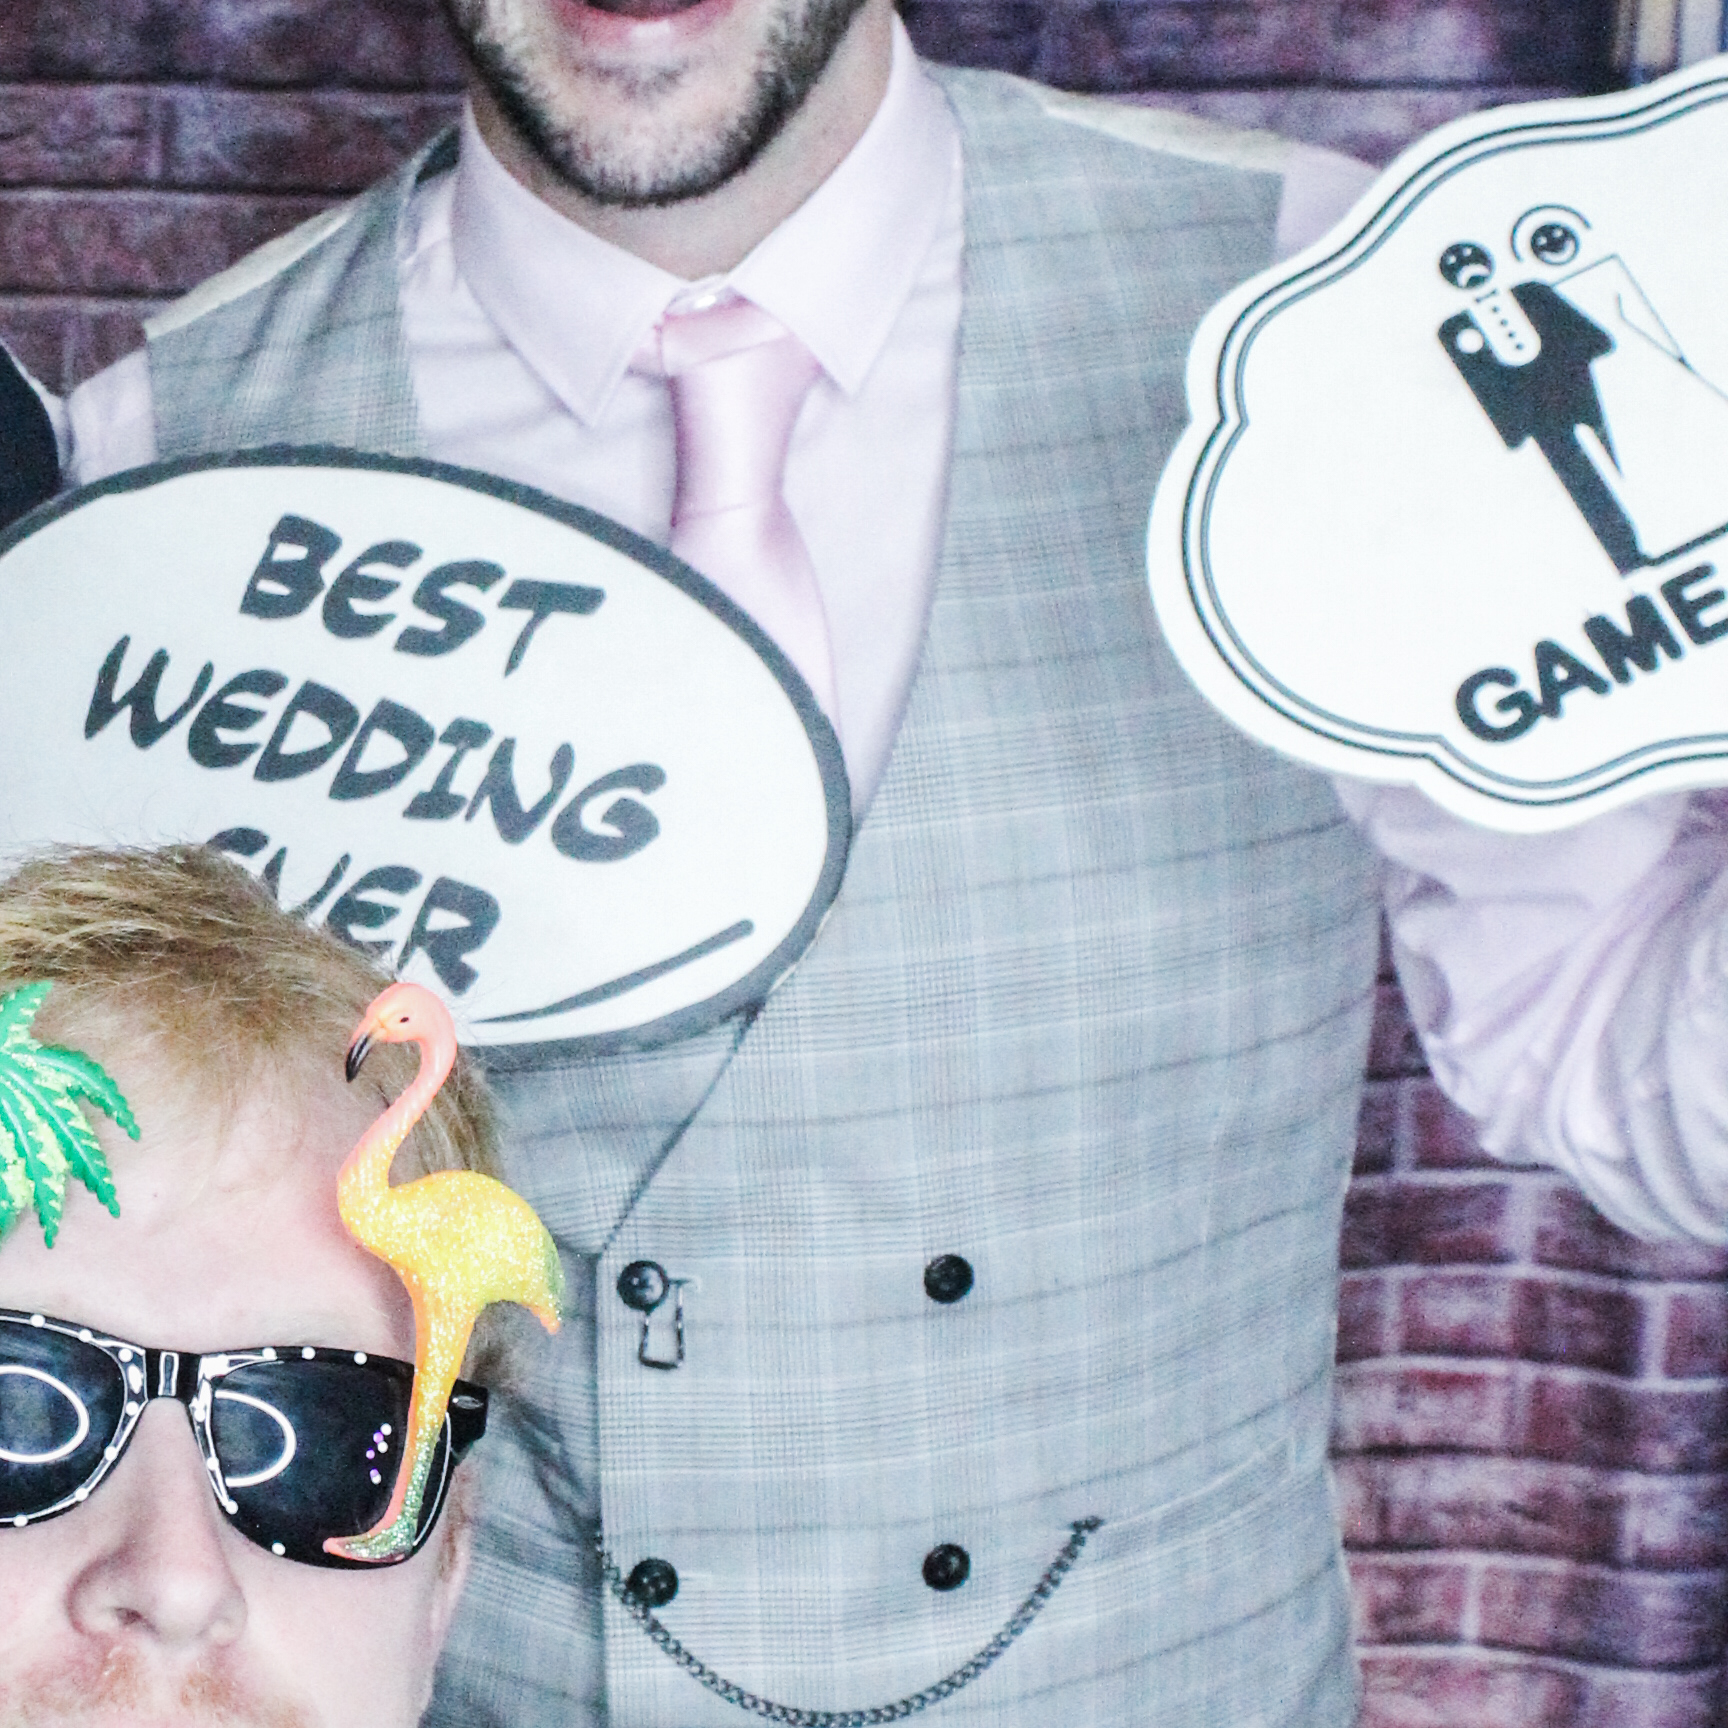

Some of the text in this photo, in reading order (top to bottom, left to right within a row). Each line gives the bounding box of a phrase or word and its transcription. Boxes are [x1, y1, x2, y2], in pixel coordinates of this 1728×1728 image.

[239, 513, 606, 678] BEST
[1455, 562, 1728, 743] GAME
[84, 634, 667, 863] WEDDING
